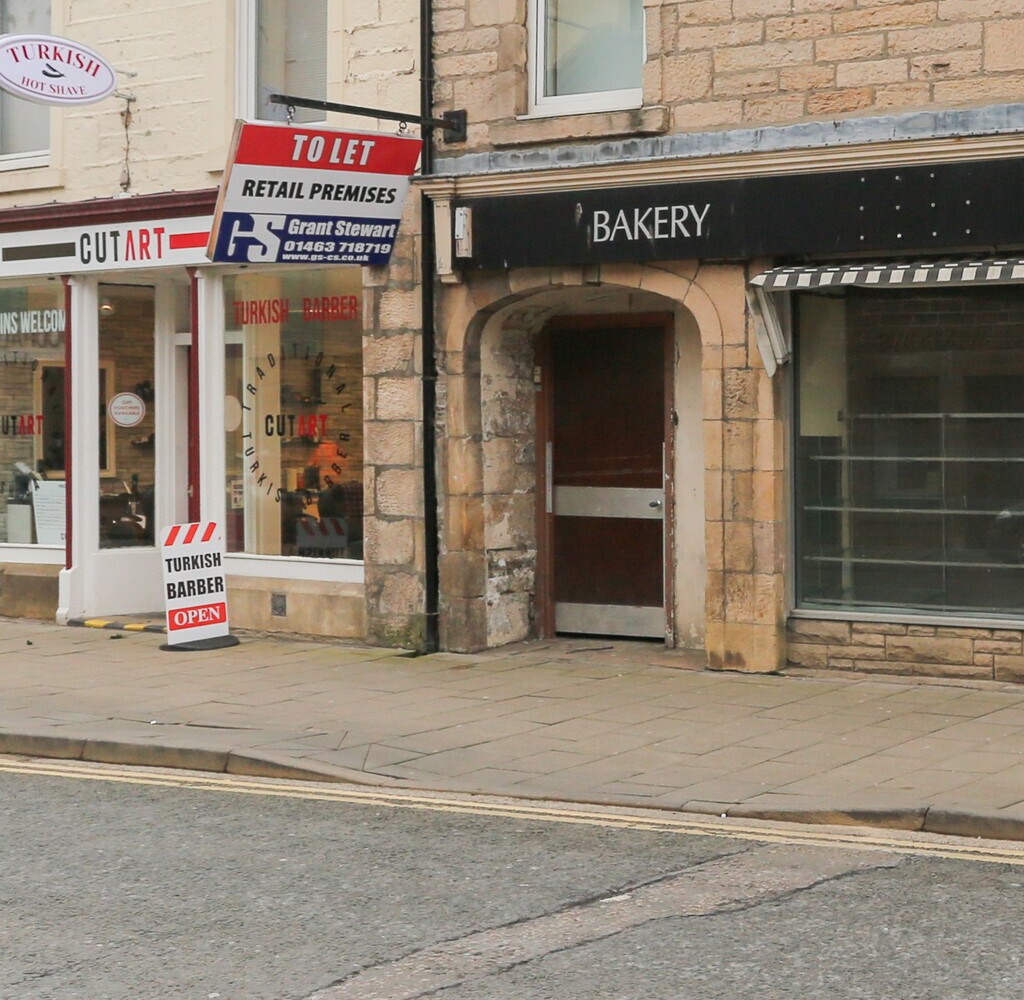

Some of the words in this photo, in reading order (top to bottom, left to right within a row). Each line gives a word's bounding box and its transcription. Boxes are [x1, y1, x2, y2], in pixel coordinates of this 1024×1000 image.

[6, 44, 100, 77] TURKISH
[21, 76, 46, 91] HOT
[49, 84, 88, 95] SHAVE
[292, 134, 325, 163] TO
[329, 138, 375, 166] LET
[242, 179, 304, 199] RETAIL
[309, 183, 397, 204] PREMISES
[288, 219, 333, 235] Grant
[335, 221, 396, 238] Stewart
[593, 204, 711, 243] BAKERY
[80, 227, 165, 264] CUTART
[284, 241, 334, 252] 01463
[339, 242, 391, 254] 718719
[282, 253, 369, 262] www.gs-cs.co.uk
[20, 309, 66, 333] WELCOM
[233, 297, 290, 327] TURKISH
[303, 295, 358, 322] BARBER
[0, 414, 44, 436] UTART
[265, 414, 328, 437] CUTART
[165, 552, 221, 573] TURKISH
[166, 576, 224, 599] BARBER
[174, 606, 221, 626] OPEN
